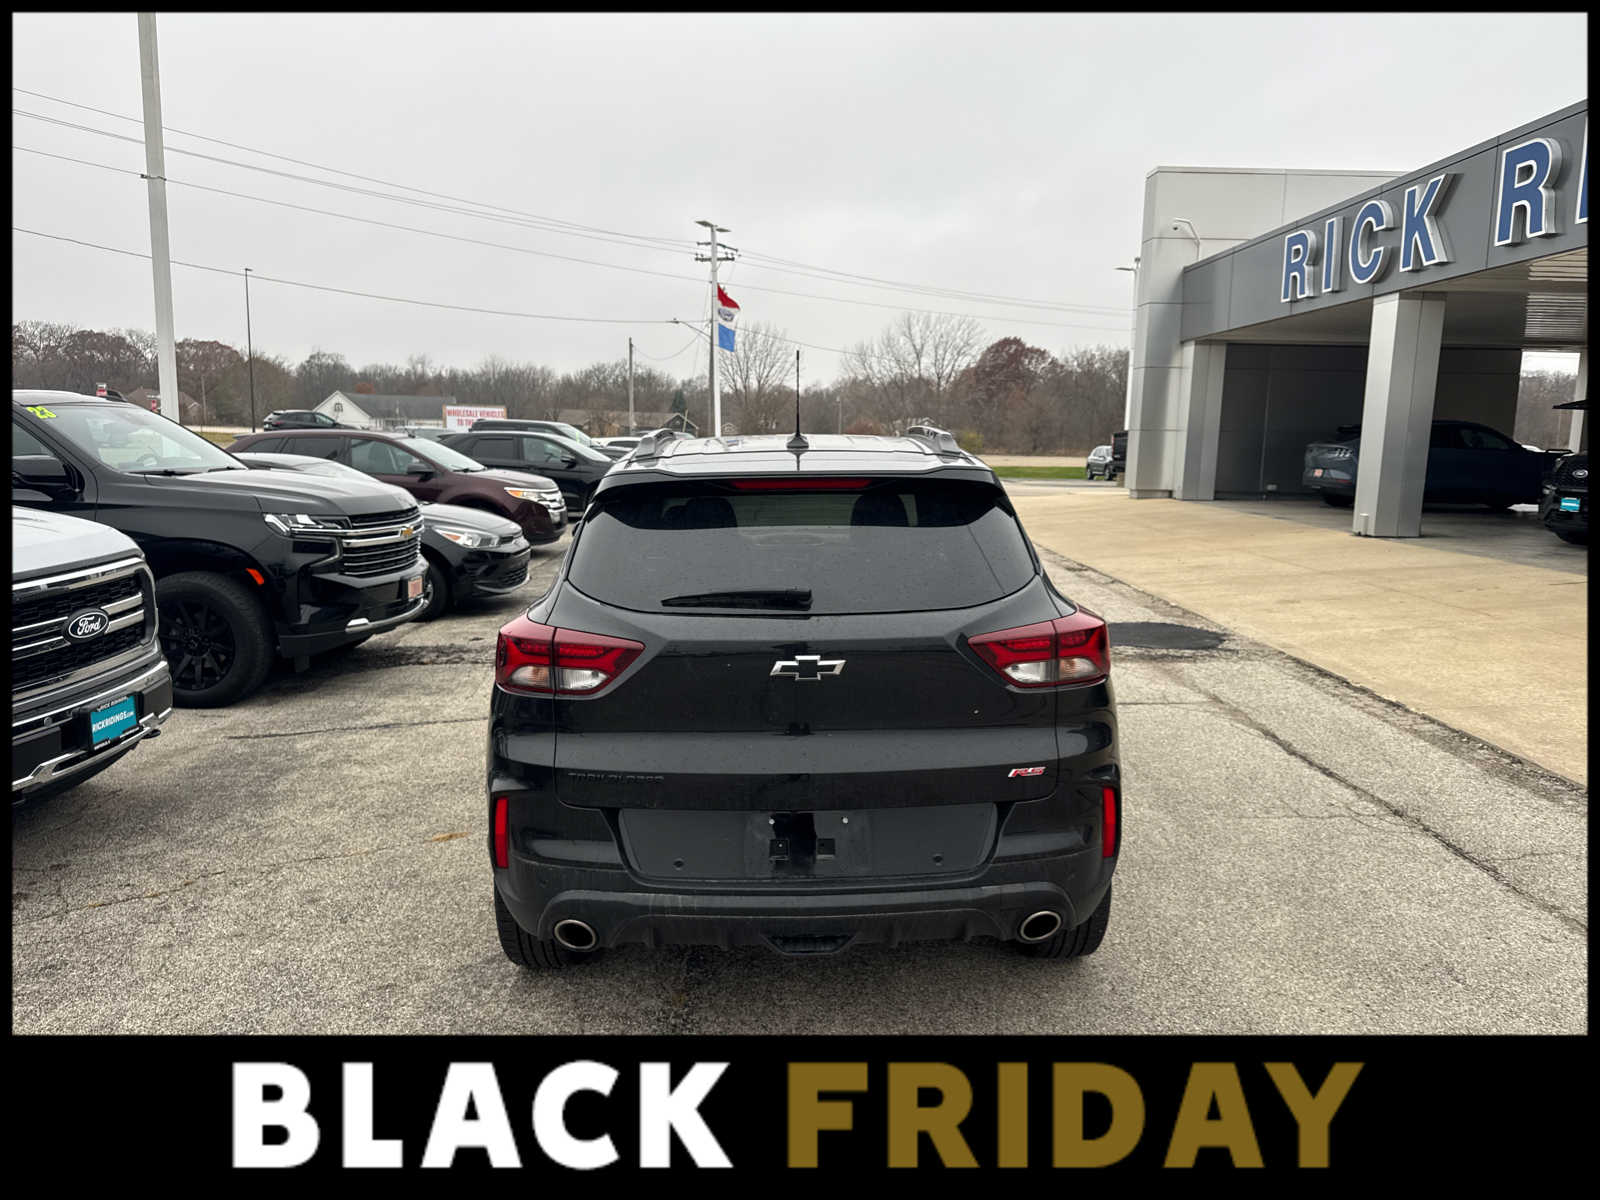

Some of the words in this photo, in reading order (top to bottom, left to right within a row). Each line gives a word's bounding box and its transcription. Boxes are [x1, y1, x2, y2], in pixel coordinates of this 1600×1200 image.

[1281, 173, 1453, 303] RICK
[77, 615, 101, 636] Ford
[1007, 766, 1047, 778] RS
